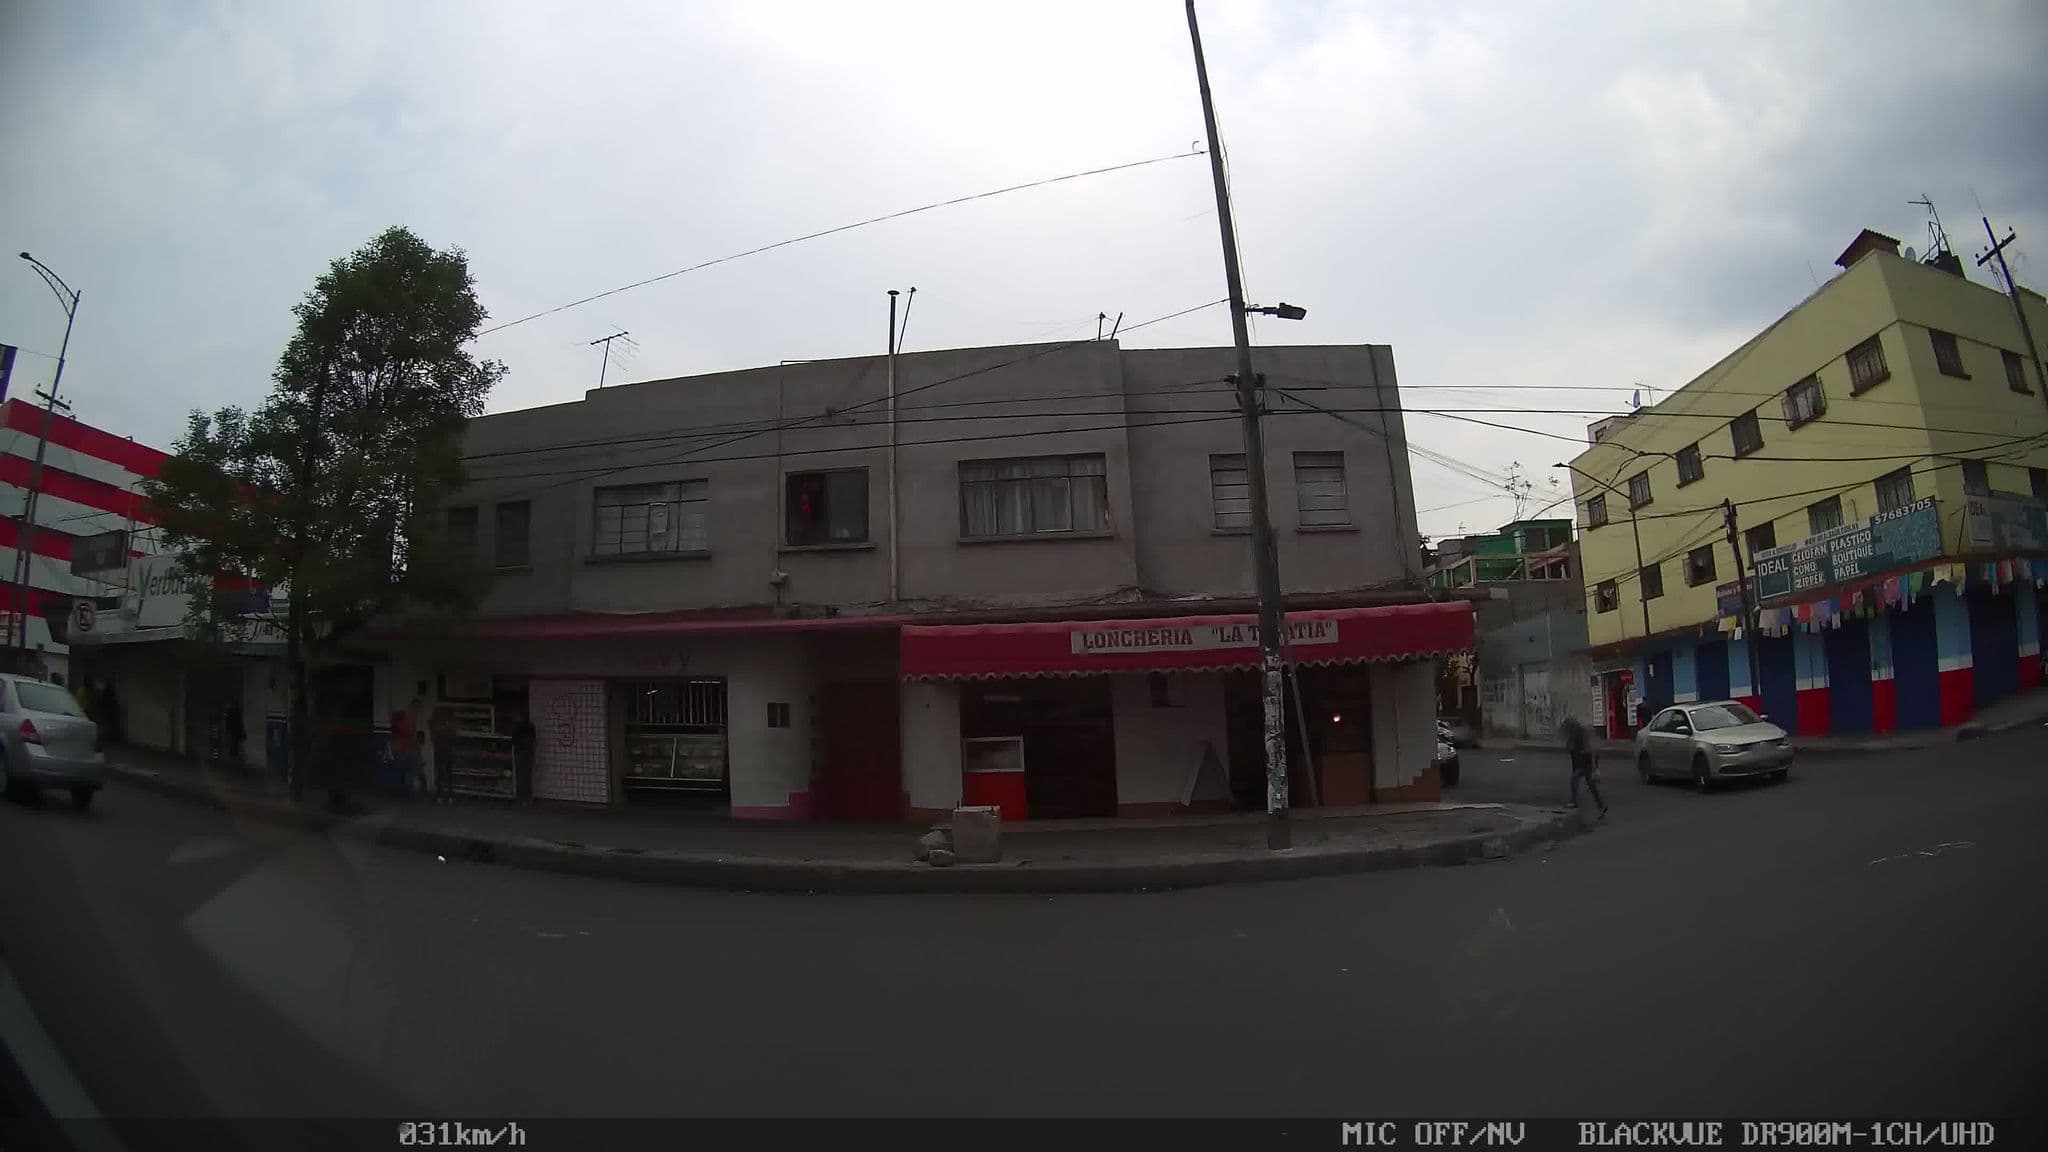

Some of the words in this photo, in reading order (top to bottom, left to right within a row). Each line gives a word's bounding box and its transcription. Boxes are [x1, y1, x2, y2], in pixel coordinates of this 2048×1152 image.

[1874, 498, 1931, 526] 57683705
[1830, 530, 1872, 552] PLASTICO
[1758, 558, 1788, 577] IDEAL
[1793, 561, 1816, 576] CONO
[1832, 544, 1873, 566] BOUTIQUE
[1834, 562, 1860, 580] PAPEL
[1082, 629, 1194, 651] LONCHERIA
[1212, 625, 1243, 642] "LA
